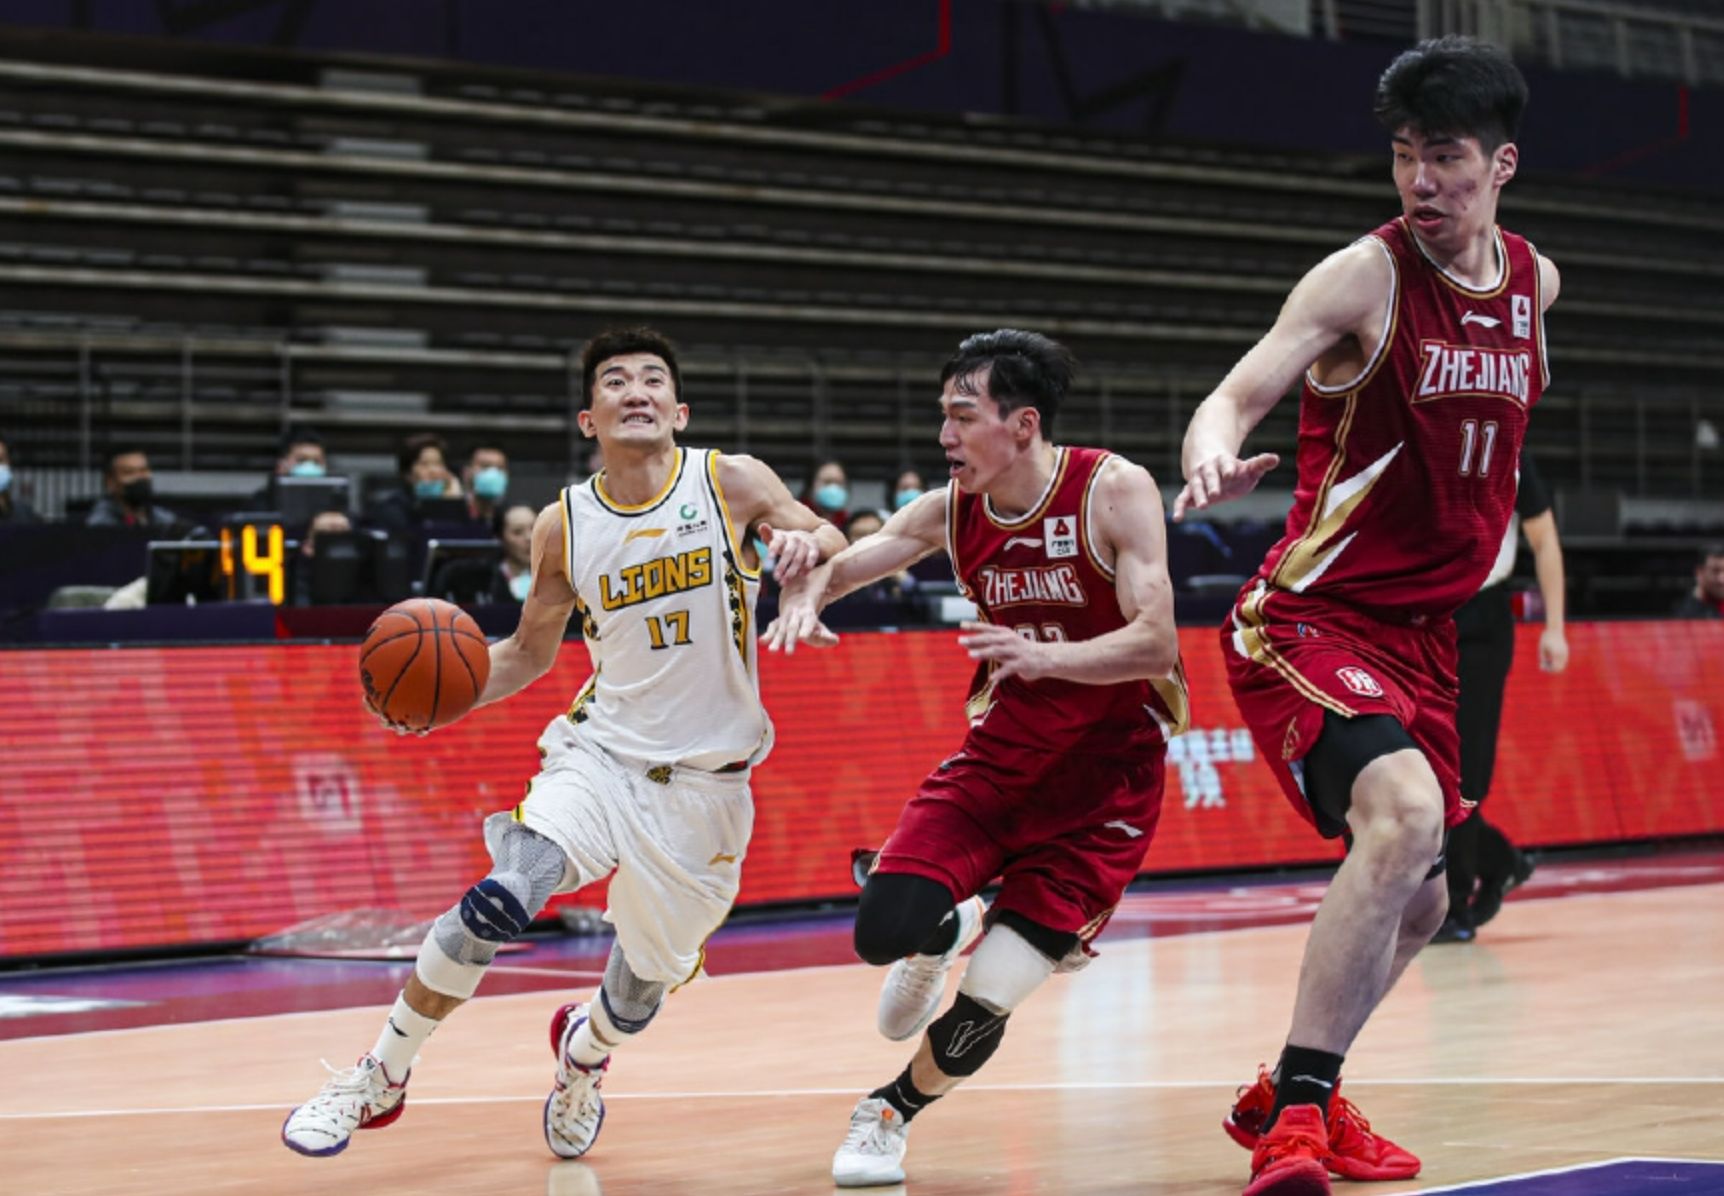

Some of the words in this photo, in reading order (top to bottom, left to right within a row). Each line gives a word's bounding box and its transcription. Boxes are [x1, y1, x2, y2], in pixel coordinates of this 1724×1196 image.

[1419, 345, 1530, 404] ZHEJIANG
[1460, 421, 1497, 476] 11
[598, 547, 713, 611] LIONS
[981, 566, 1085, 606] ZHEJIANG
[644, 610, 693, 650] 17
